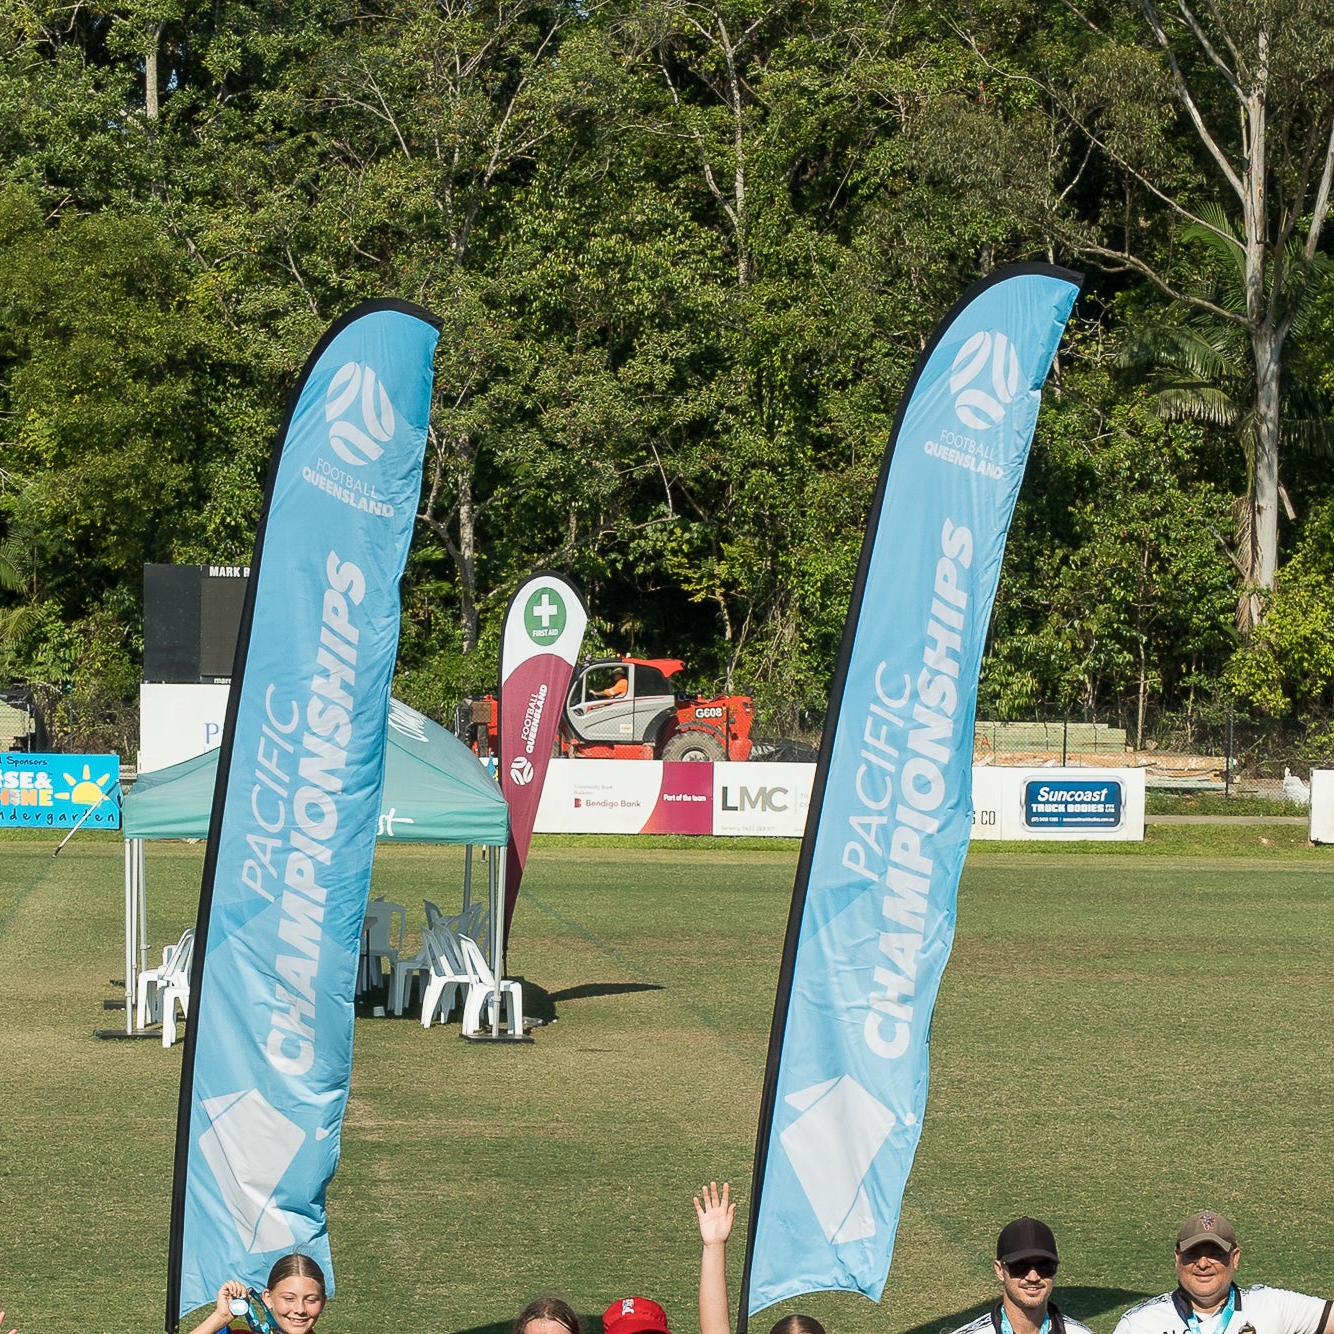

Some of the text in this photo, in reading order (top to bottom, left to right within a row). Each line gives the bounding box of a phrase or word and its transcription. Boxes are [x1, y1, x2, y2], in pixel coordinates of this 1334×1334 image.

[924, 440, 1004, 481] QUEENSLAND
[940, 429, 995, 460] FOOTBALL
[301, 466, 395, 518] QUEENSLAND
[316, 457, 379, 498] FOOTBALL
[209, 566, 240, 577] MARK
[547, 629, 559, 637] AID
[521, 693, 538, 741] FOOTBALL
[526, 684, 547, 754] QUEENSLAND
[695, 708, 722, 718] G608
[6, 755, 48, 767] Sponsors
[842, 660, 911, 880] PACIFIC
[241, 683, 300, 902] PACIFIC
[585, 799, 641, 809] Bendigo Bank
[722, 786, 788, 811] LMC
[864, 518, 973, 1060] CHAMPIONSHIPS
[1037, 786, 1108, 801] Suncoast
[267, 549, 366, 1077] CHAMPIONSHIPS
[1031, 804, 1066, 813] TRUCK
[1067, 804, 1104, 813] BODIES
